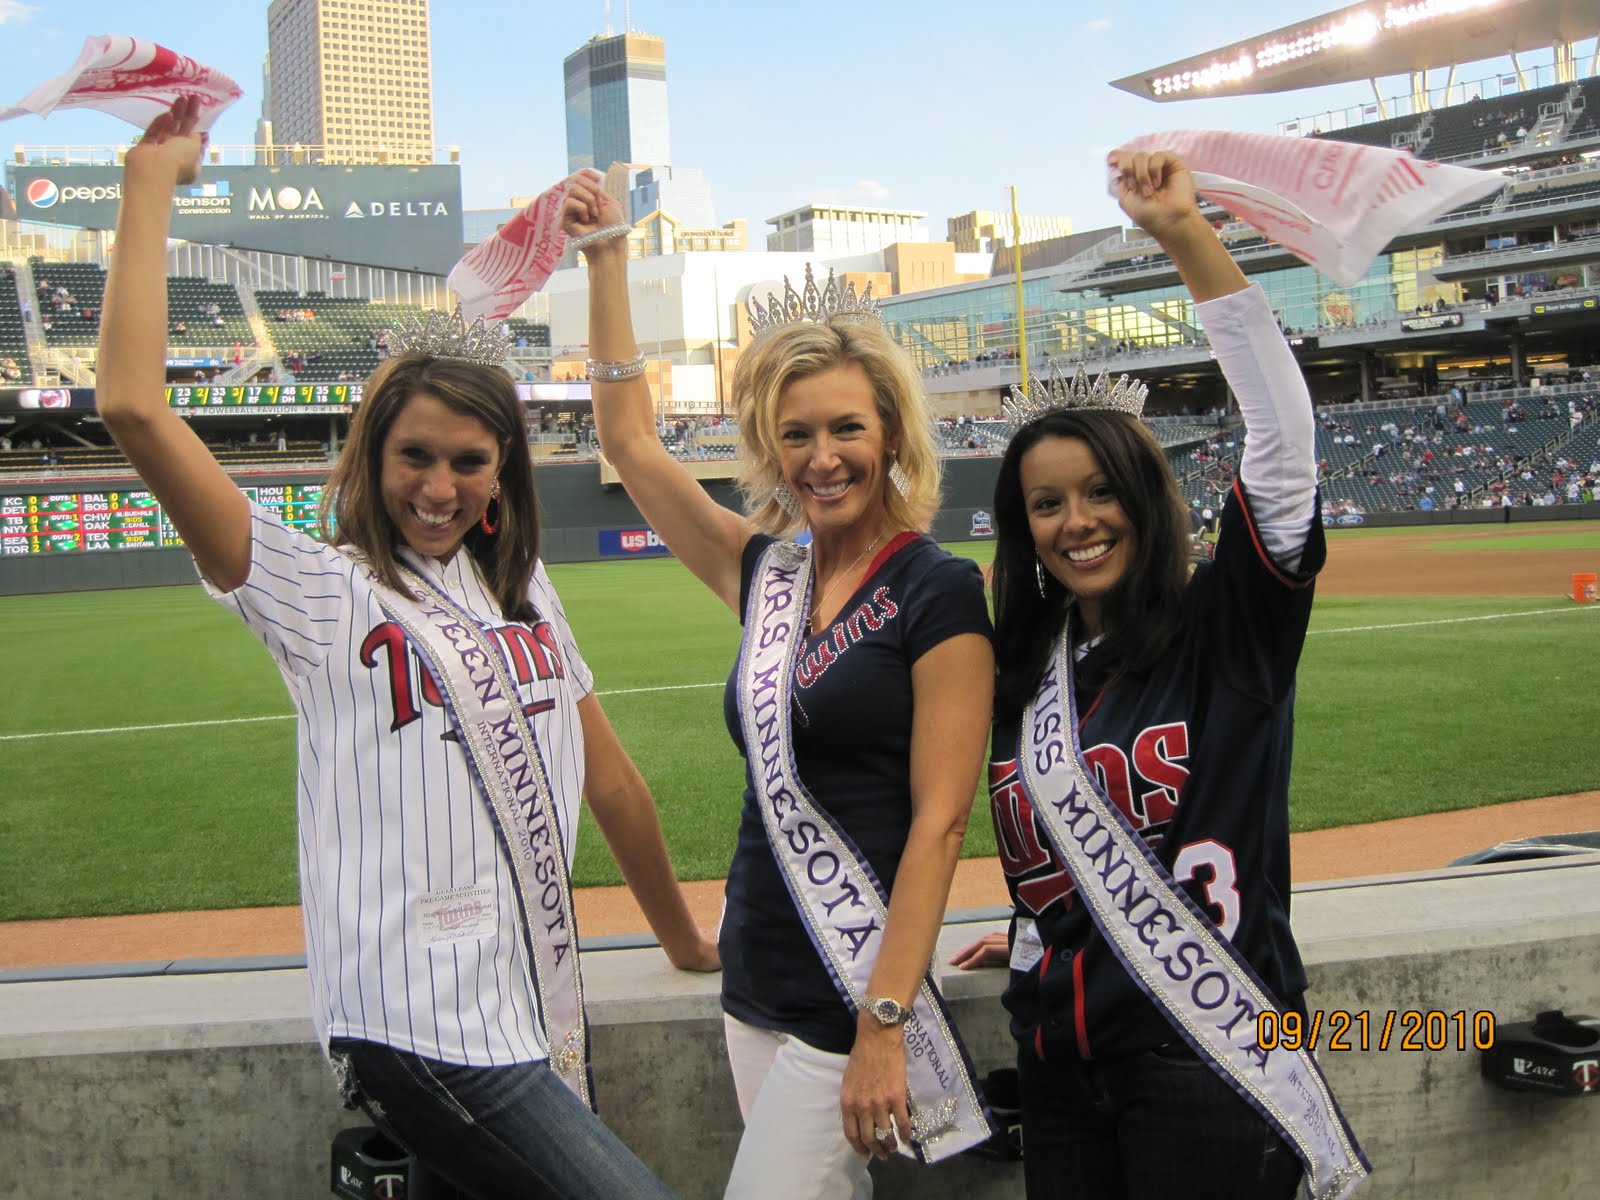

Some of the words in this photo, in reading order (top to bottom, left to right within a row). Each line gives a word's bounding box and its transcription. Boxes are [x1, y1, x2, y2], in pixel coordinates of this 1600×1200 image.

[62, 184, 121, 203] pepsi
[173, 196, 230, 207] tenson
[371, 202, 448, 216] DELTA
[178, 388, 191, 396] 23
[213, 388, 226, 396] 33
[249, 387, 262, 396] 17
[283, 387, 296, 395] 48
[316, 386, 329, 394] 35
[351, 386, 363, 394] 25
[282, 395, 295, 403] DH
[261, 487, 283, 495] HOU
[286, 486, 292, 494] 3
[5, 497, 23, 506] KC
[30, 496, 37, 504] 0
[84, 494, 107, 502] BAL
[111, 493, 118, 501] 0
[3, 506, 26, 514] DET
[31, 505, 38, 513] 0
[85, 503, 108, 511] BOS
[112, 502, 118, 510] 0
[7, 517, 23, 525] TB
[83, 513, 111, 521] CHW
[3, 525, 28, 533] NYY
[85, 522, 110, 530] OAK
[4, 537, 28, 545] SEA
[74, 533, 80, 541] 2
[86, 533, 109, 541] TEX
[4, 546, 29, 554] TOR
[32, 545, 40, 553] 2
[87, 542, 110, 550] LAA
[755, 566, 800, 658] MRS.
[420, 602, 507, 709] TEEN
[487, 711, 570, 972] MINNESOTA
[476, 720, 519, 826] INTERNATIONAL
[517, 829, 532, 861] 2010
[753, 659, 881, 961] MINNESOTA
[1034, 657, 1066, 775] MISS
[1052, 780, 1272, 1075] MINNESOTA
[903, 1026, 924, 1058] 2010
[1304, 1108, 1320, 1136] 2010
